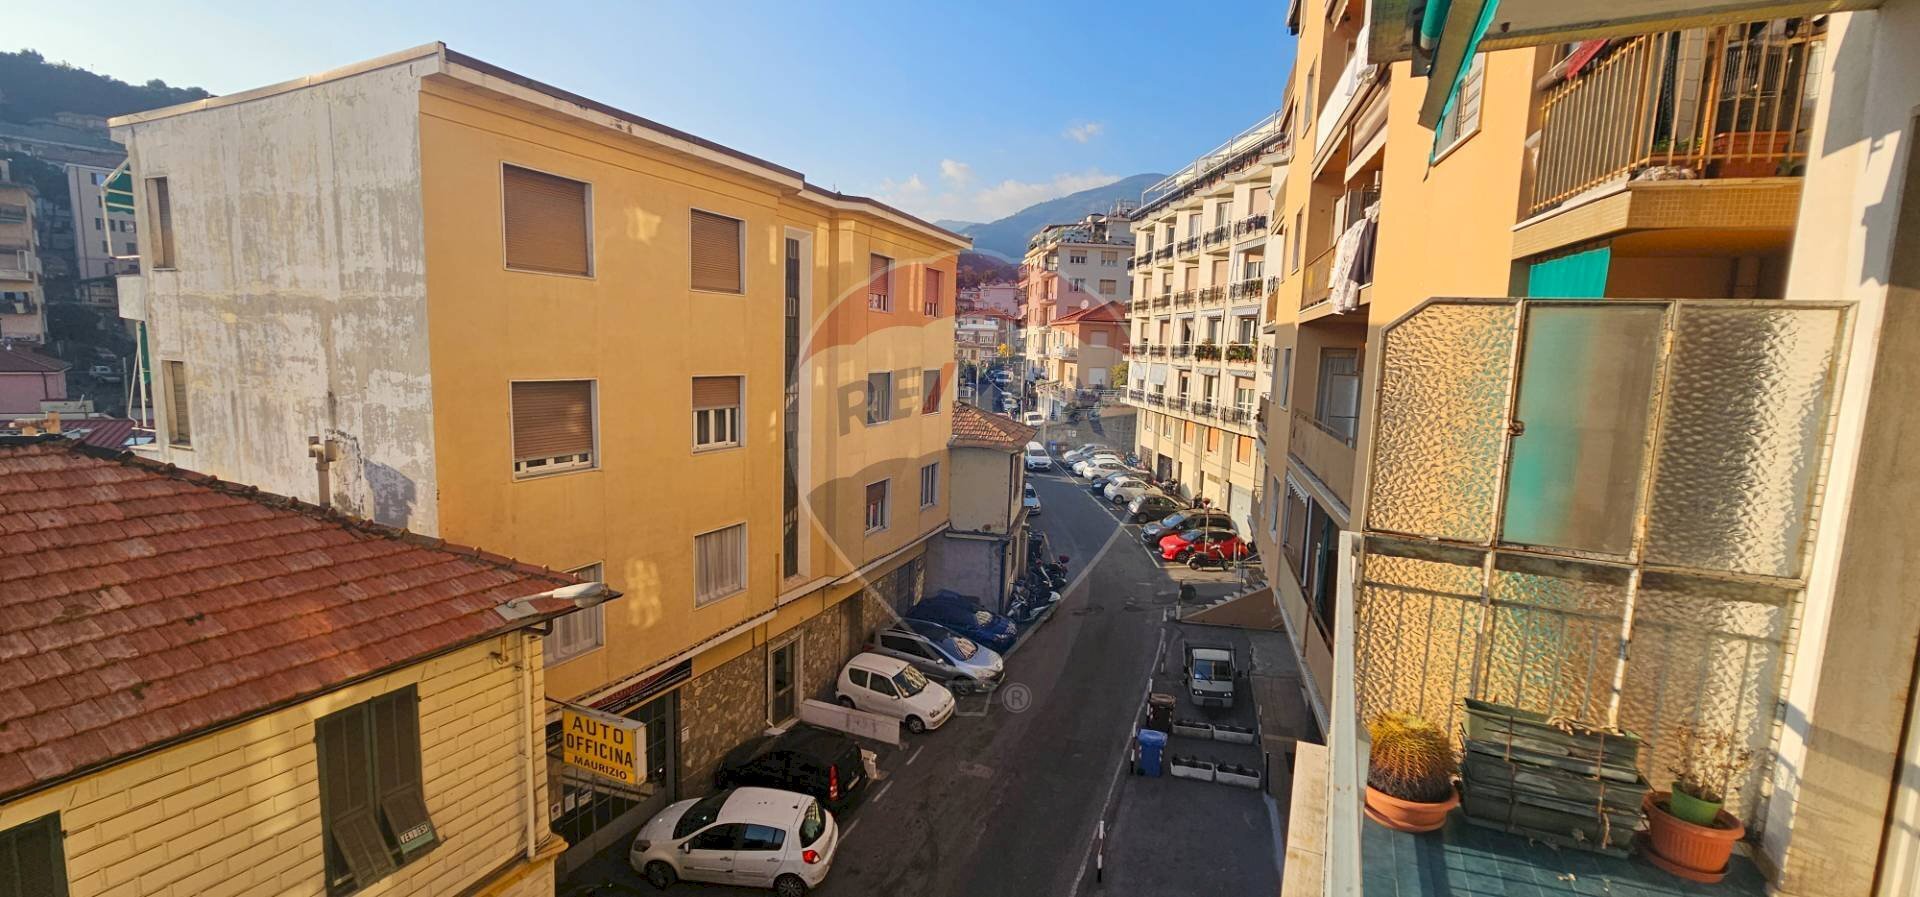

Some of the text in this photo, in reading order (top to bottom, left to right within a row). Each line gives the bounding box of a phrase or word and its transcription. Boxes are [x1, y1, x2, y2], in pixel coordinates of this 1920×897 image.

[572, 716, 624, 745] AUTO
[566, 733, 633, 768] OFFICINA
[574, 755, 627, 780] MAURIZIO
